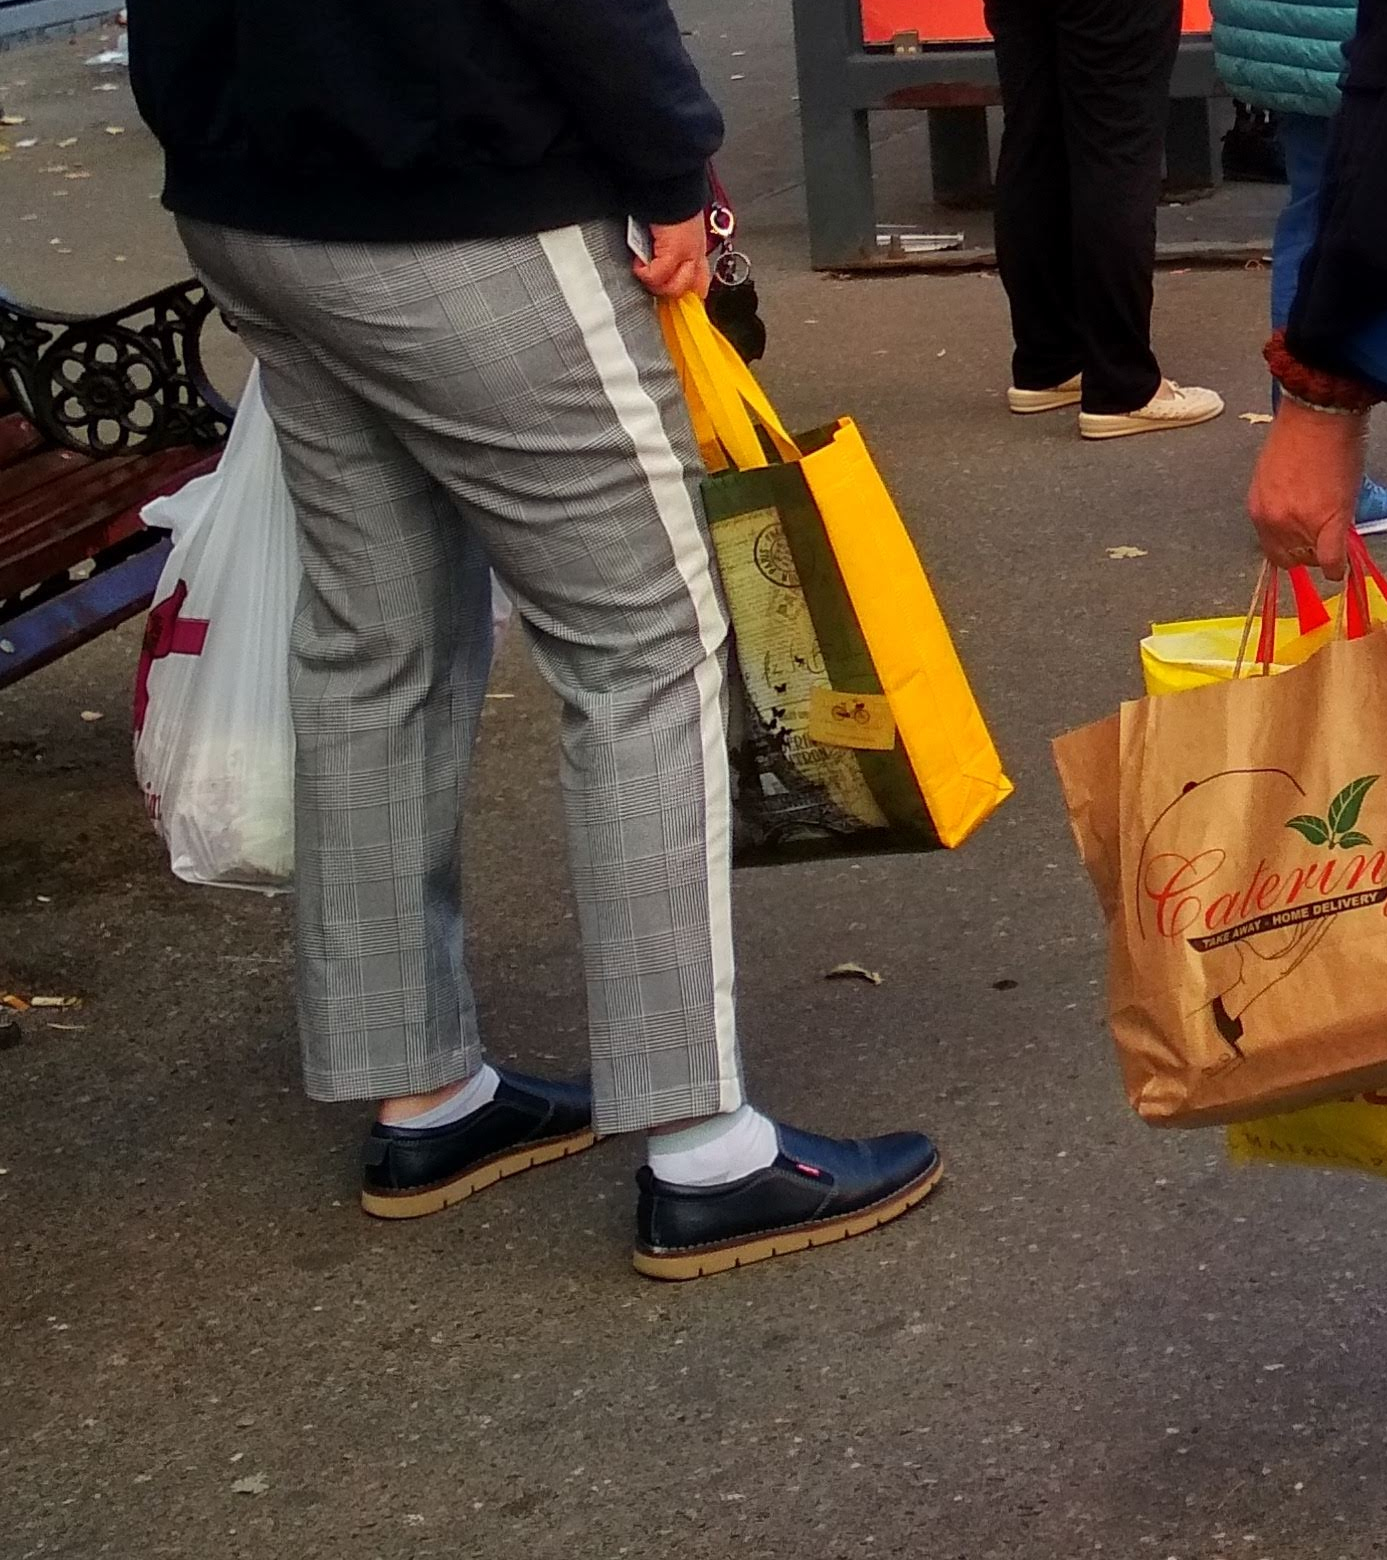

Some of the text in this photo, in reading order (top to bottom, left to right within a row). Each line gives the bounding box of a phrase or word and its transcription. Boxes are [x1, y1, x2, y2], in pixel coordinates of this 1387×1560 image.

[1202, 891, 1379, 949] TAKE AWAY HOME DELIVERY
